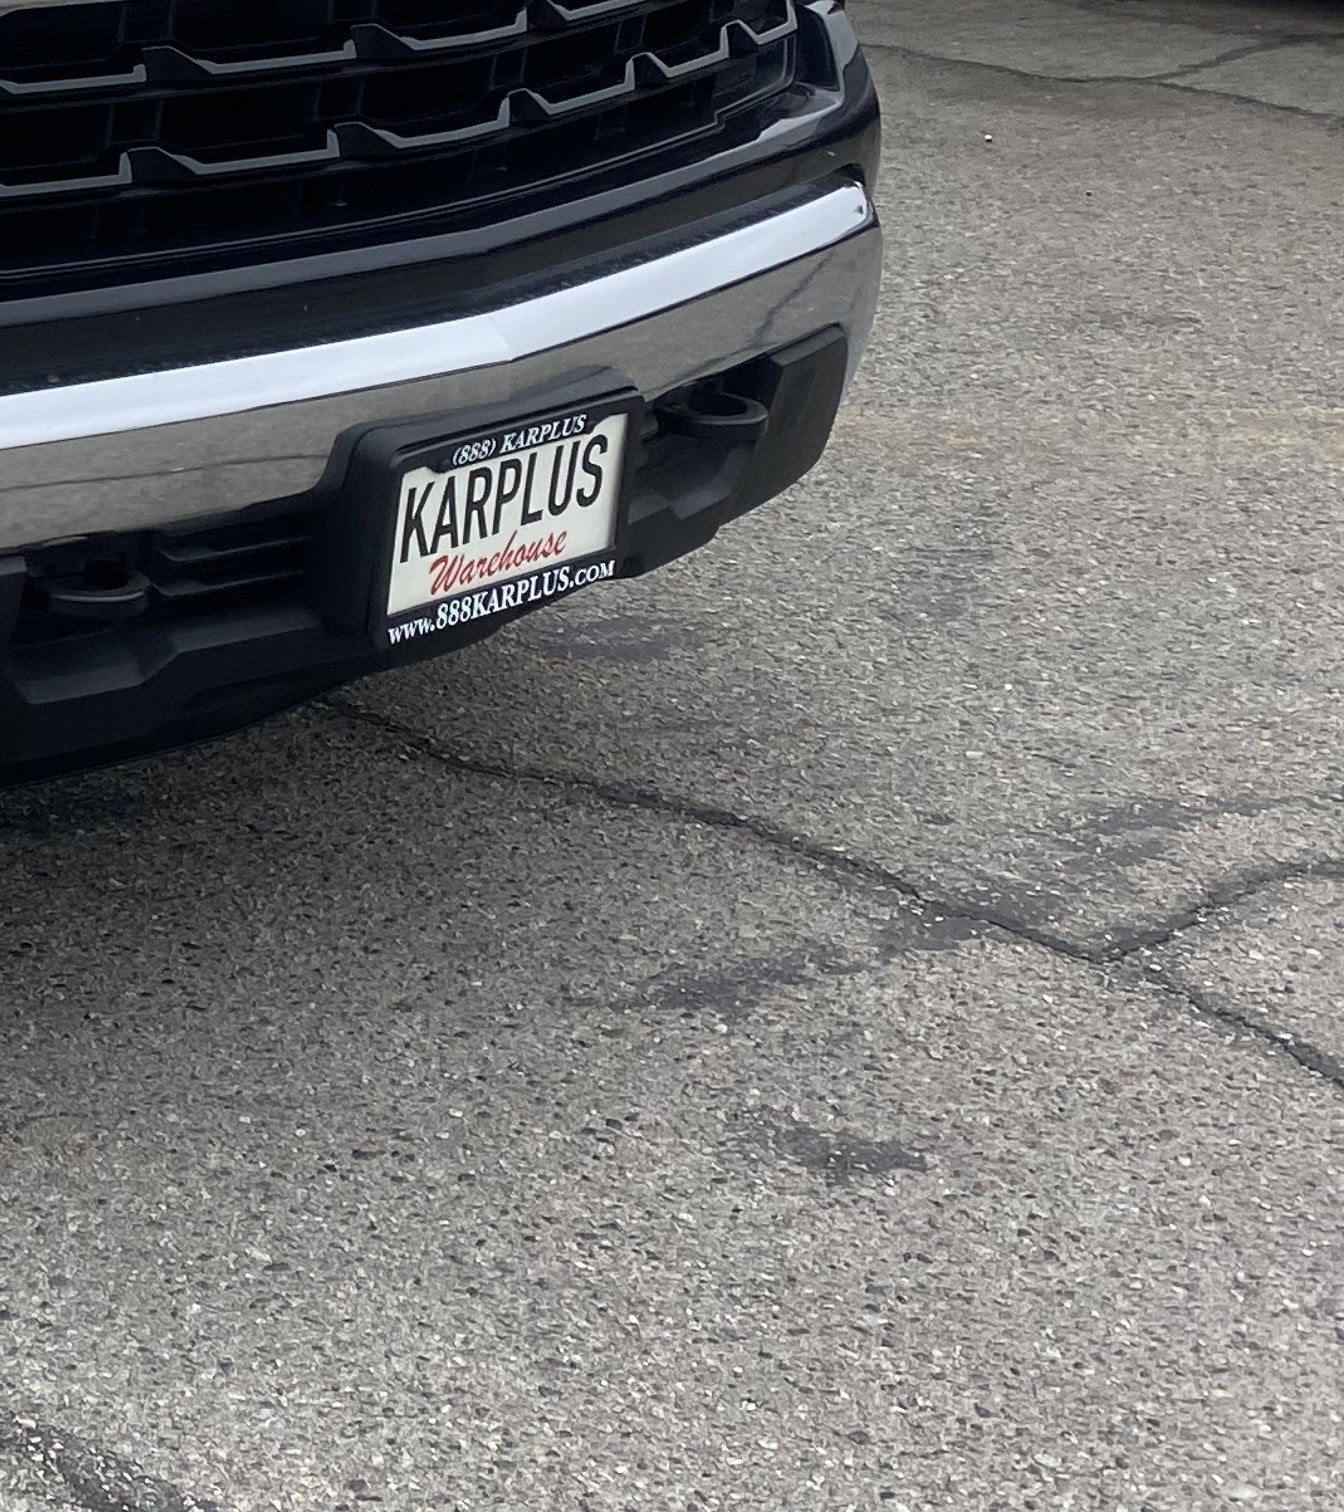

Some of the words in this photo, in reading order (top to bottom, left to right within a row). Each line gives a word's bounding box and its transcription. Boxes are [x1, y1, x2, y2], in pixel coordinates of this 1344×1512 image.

[452, 439, 497, 466] (888)
[499, 414, 587, 455] KARPLUS
[399, 434, 609, 564] KARPLUS
[428, 529, 568, 596] Warehouse
